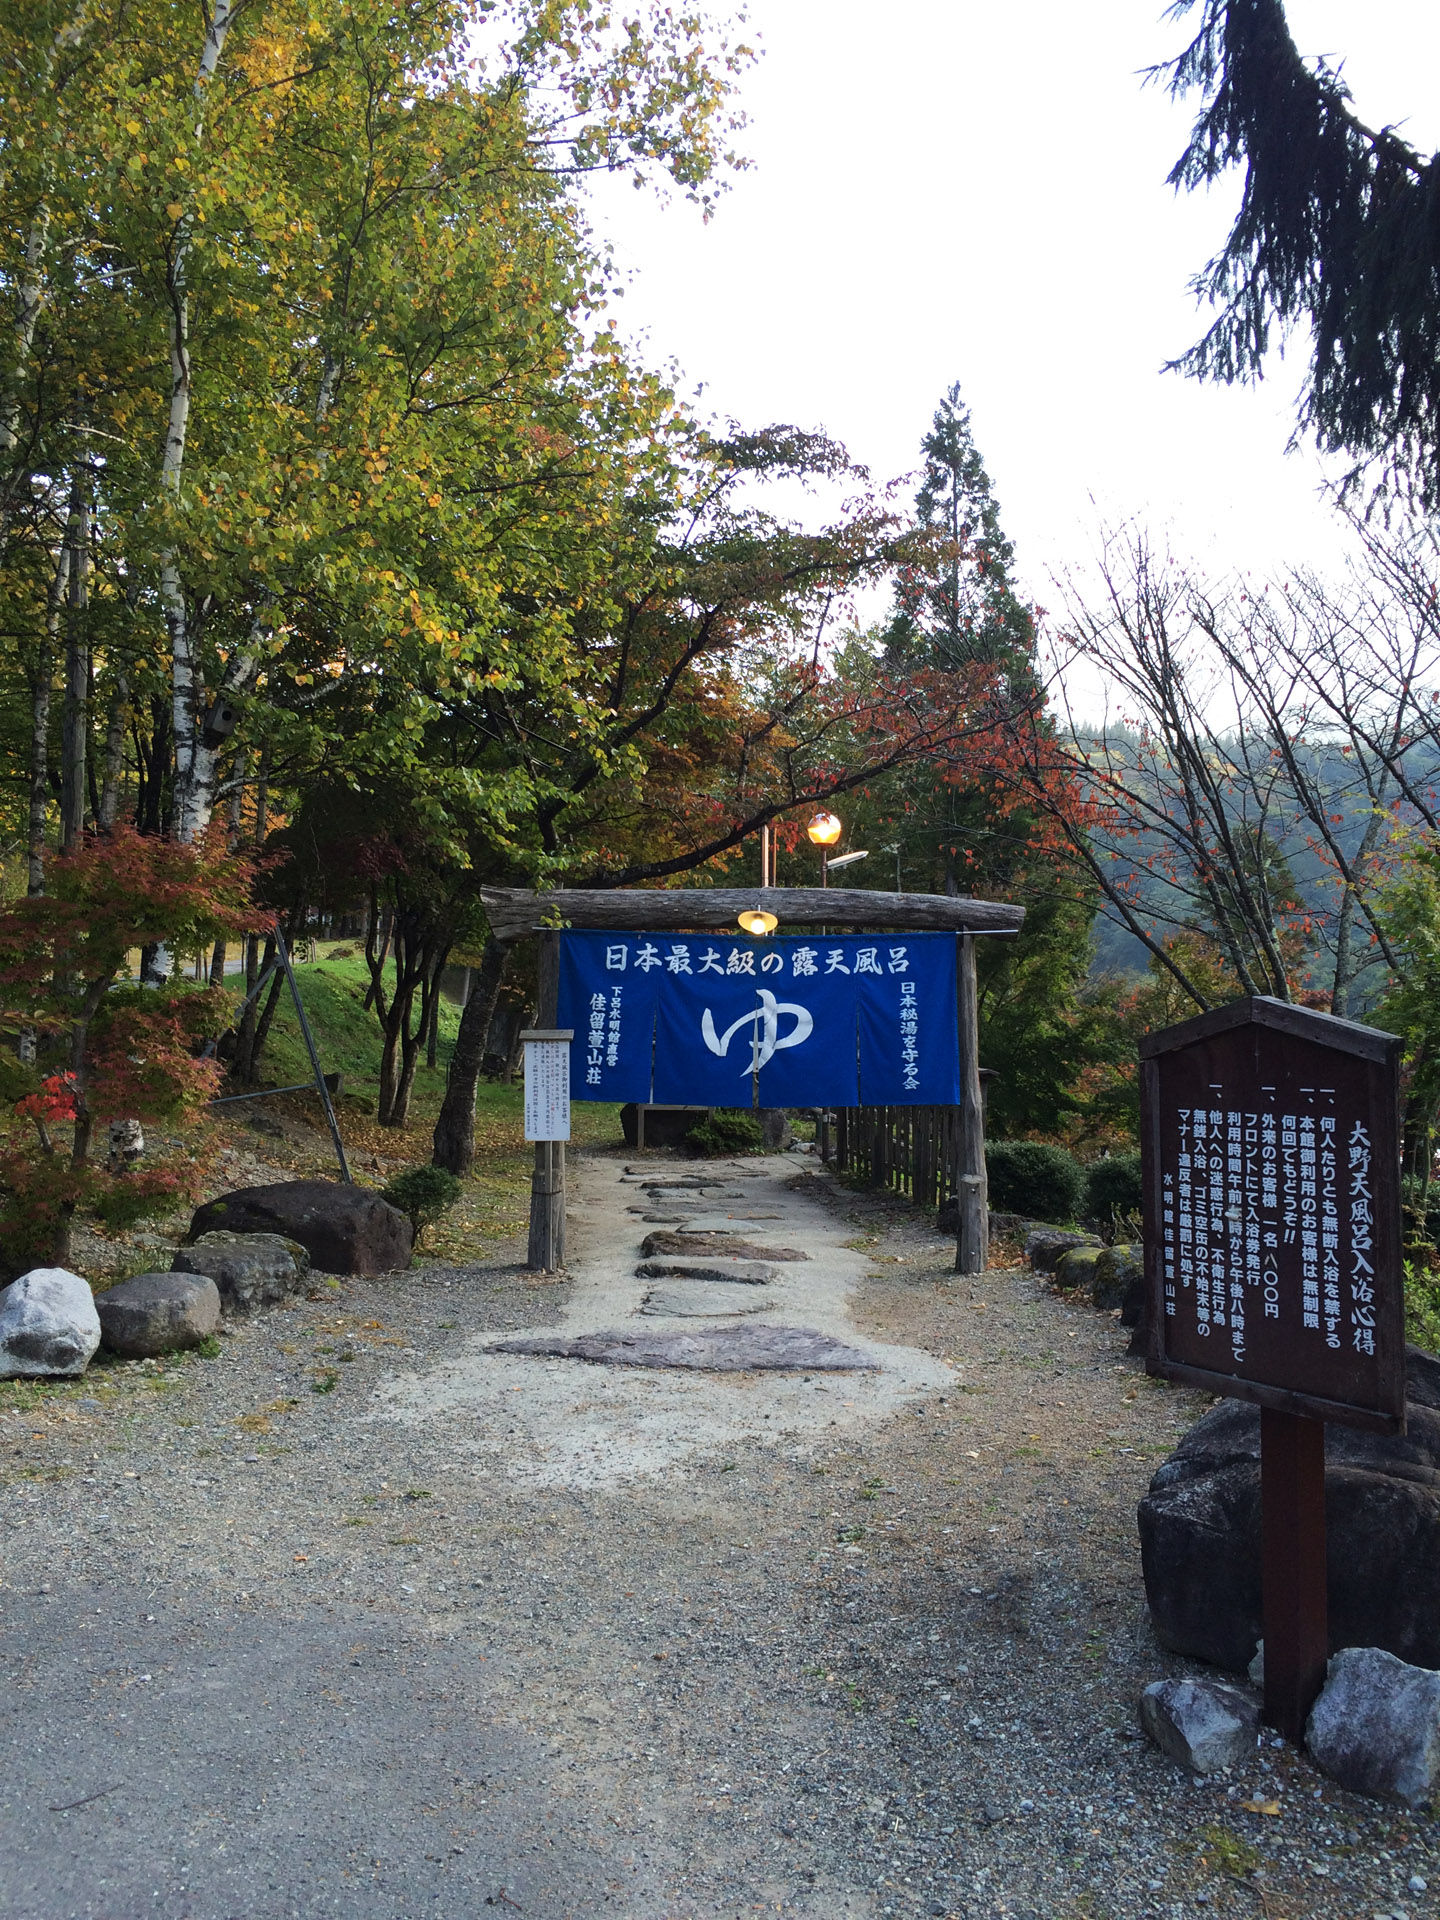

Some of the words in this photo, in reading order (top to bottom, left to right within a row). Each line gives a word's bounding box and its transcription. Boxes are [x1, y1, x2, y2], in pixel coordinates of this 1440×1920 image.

[605, 943, 911, 977] 日本最大級の露天風呂
[586, 993, 607, 1085] 佳留萱山荘
[606, 986, 623, 1067] 下呂水明館直営
[701, 988, 814, 1078] ゆ
[899, 982, 920, 1090] 日本秘湯を守る会
[1244, 1113, 1261, 1286] フロントにて入浴券発行
[1348, 1120, 1376, 1356] 大野天風呂入浴心得
